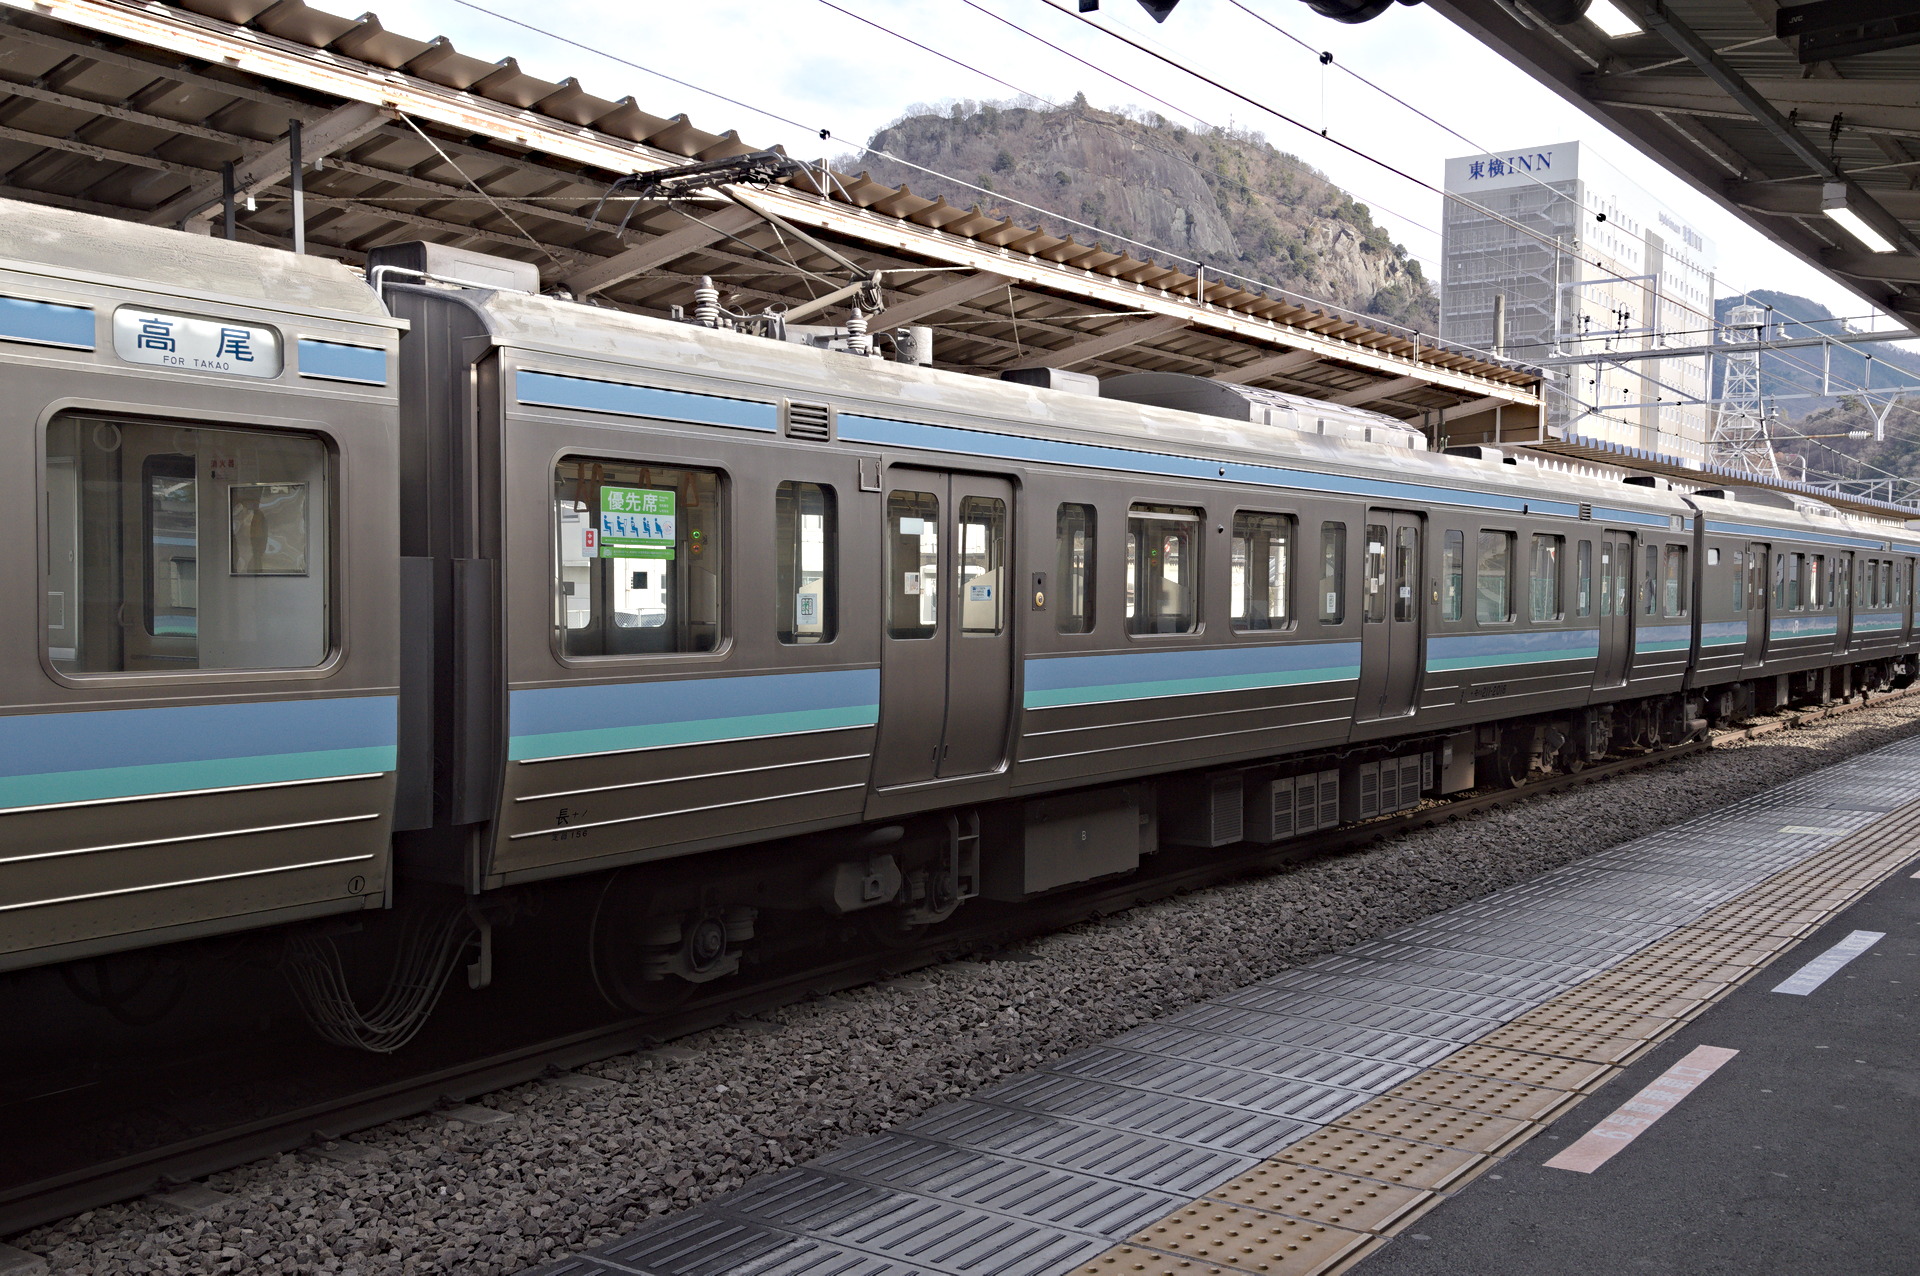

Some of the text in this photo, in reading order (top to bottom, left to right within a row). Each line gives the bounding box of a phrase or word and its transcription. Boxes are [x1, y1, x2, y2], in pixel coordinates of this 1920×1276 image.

[1788, 15, 1803, 24] JVC
[1468, 152, 1552, 180] 東横INN
[137, 318, 254, 362] 高尾
[163, 355, 230, 371] FOR TAKAO
[608, 491, 658, 512] 優先席
[1081, 830, 1087, 841] B
